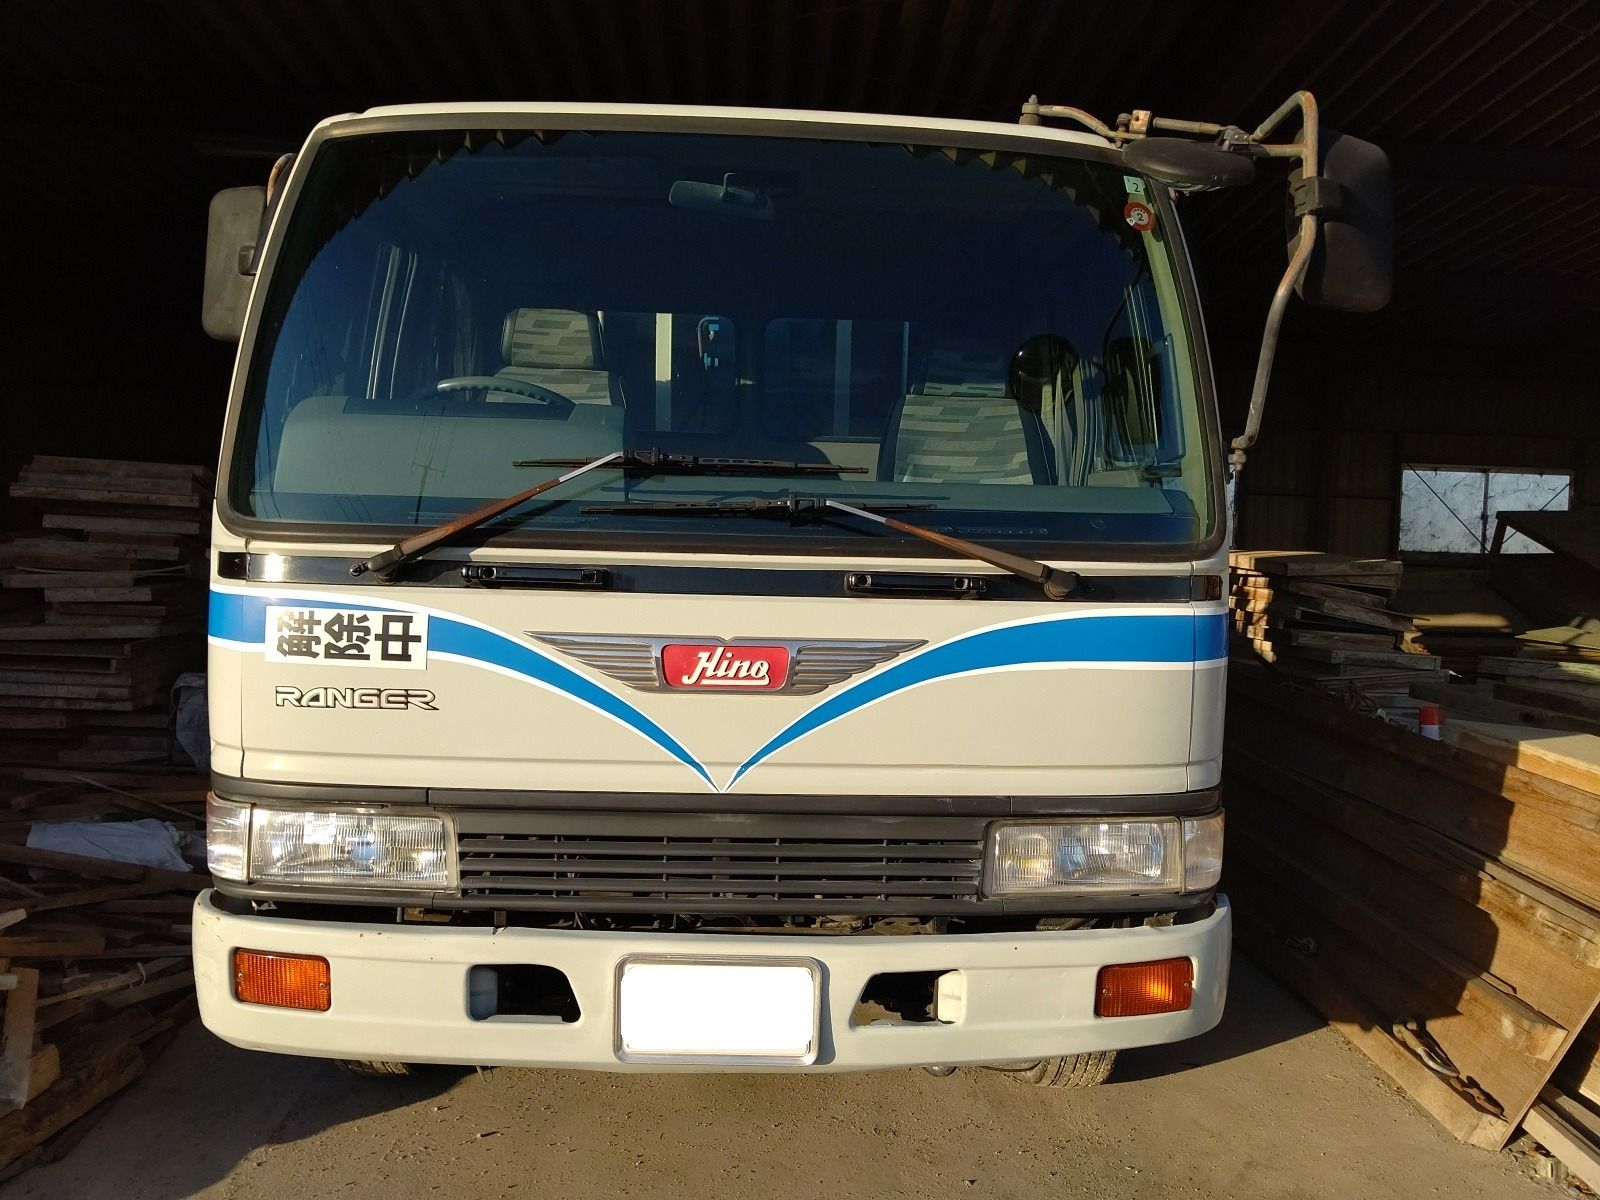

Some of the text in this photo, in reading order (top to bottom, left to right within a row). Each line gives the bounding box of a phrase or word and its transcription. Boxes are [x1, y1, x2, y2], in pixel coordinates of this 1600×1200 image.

[1132, 182, 1141, 192] 2
[1136, 212, 1145, 222] 2
[276, 609, 422, 662] 解除中
[681, 646, 771, 686] Hino
[275, 685, 440, 711] RANGER
